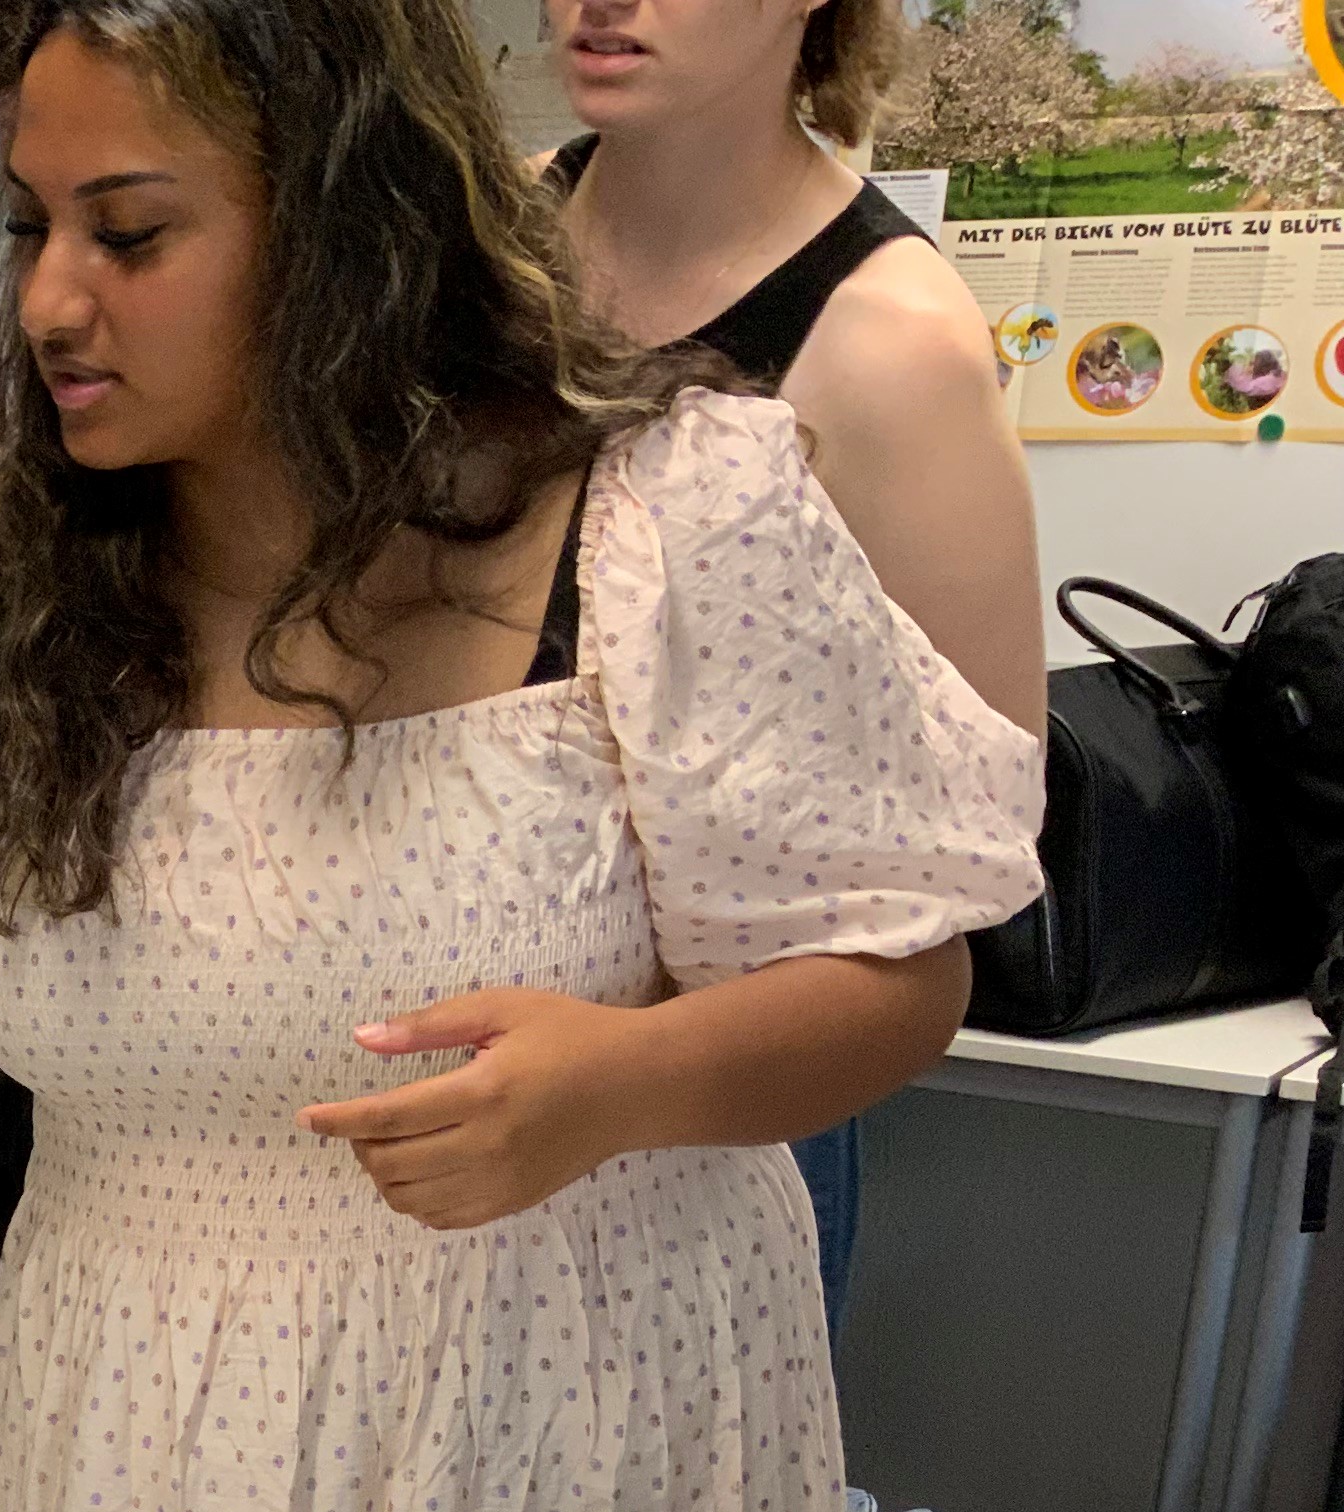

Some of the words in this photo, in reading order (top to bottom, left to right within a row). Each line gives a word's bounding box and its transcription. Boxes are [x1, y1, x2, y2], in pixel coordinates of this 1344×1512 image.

[958, 228, 1005, 244] MIT
[1011, 226, 1047, 243] DER
[1054, 224, 1114, 240] BIENE
[1123, 222, 1166, 239] VON
[1173, 216, 1233, 237] BLÜTE
[1242, 219, 1272, 235] ZU
[1280, 213, 1342, 235] BLÜTE
